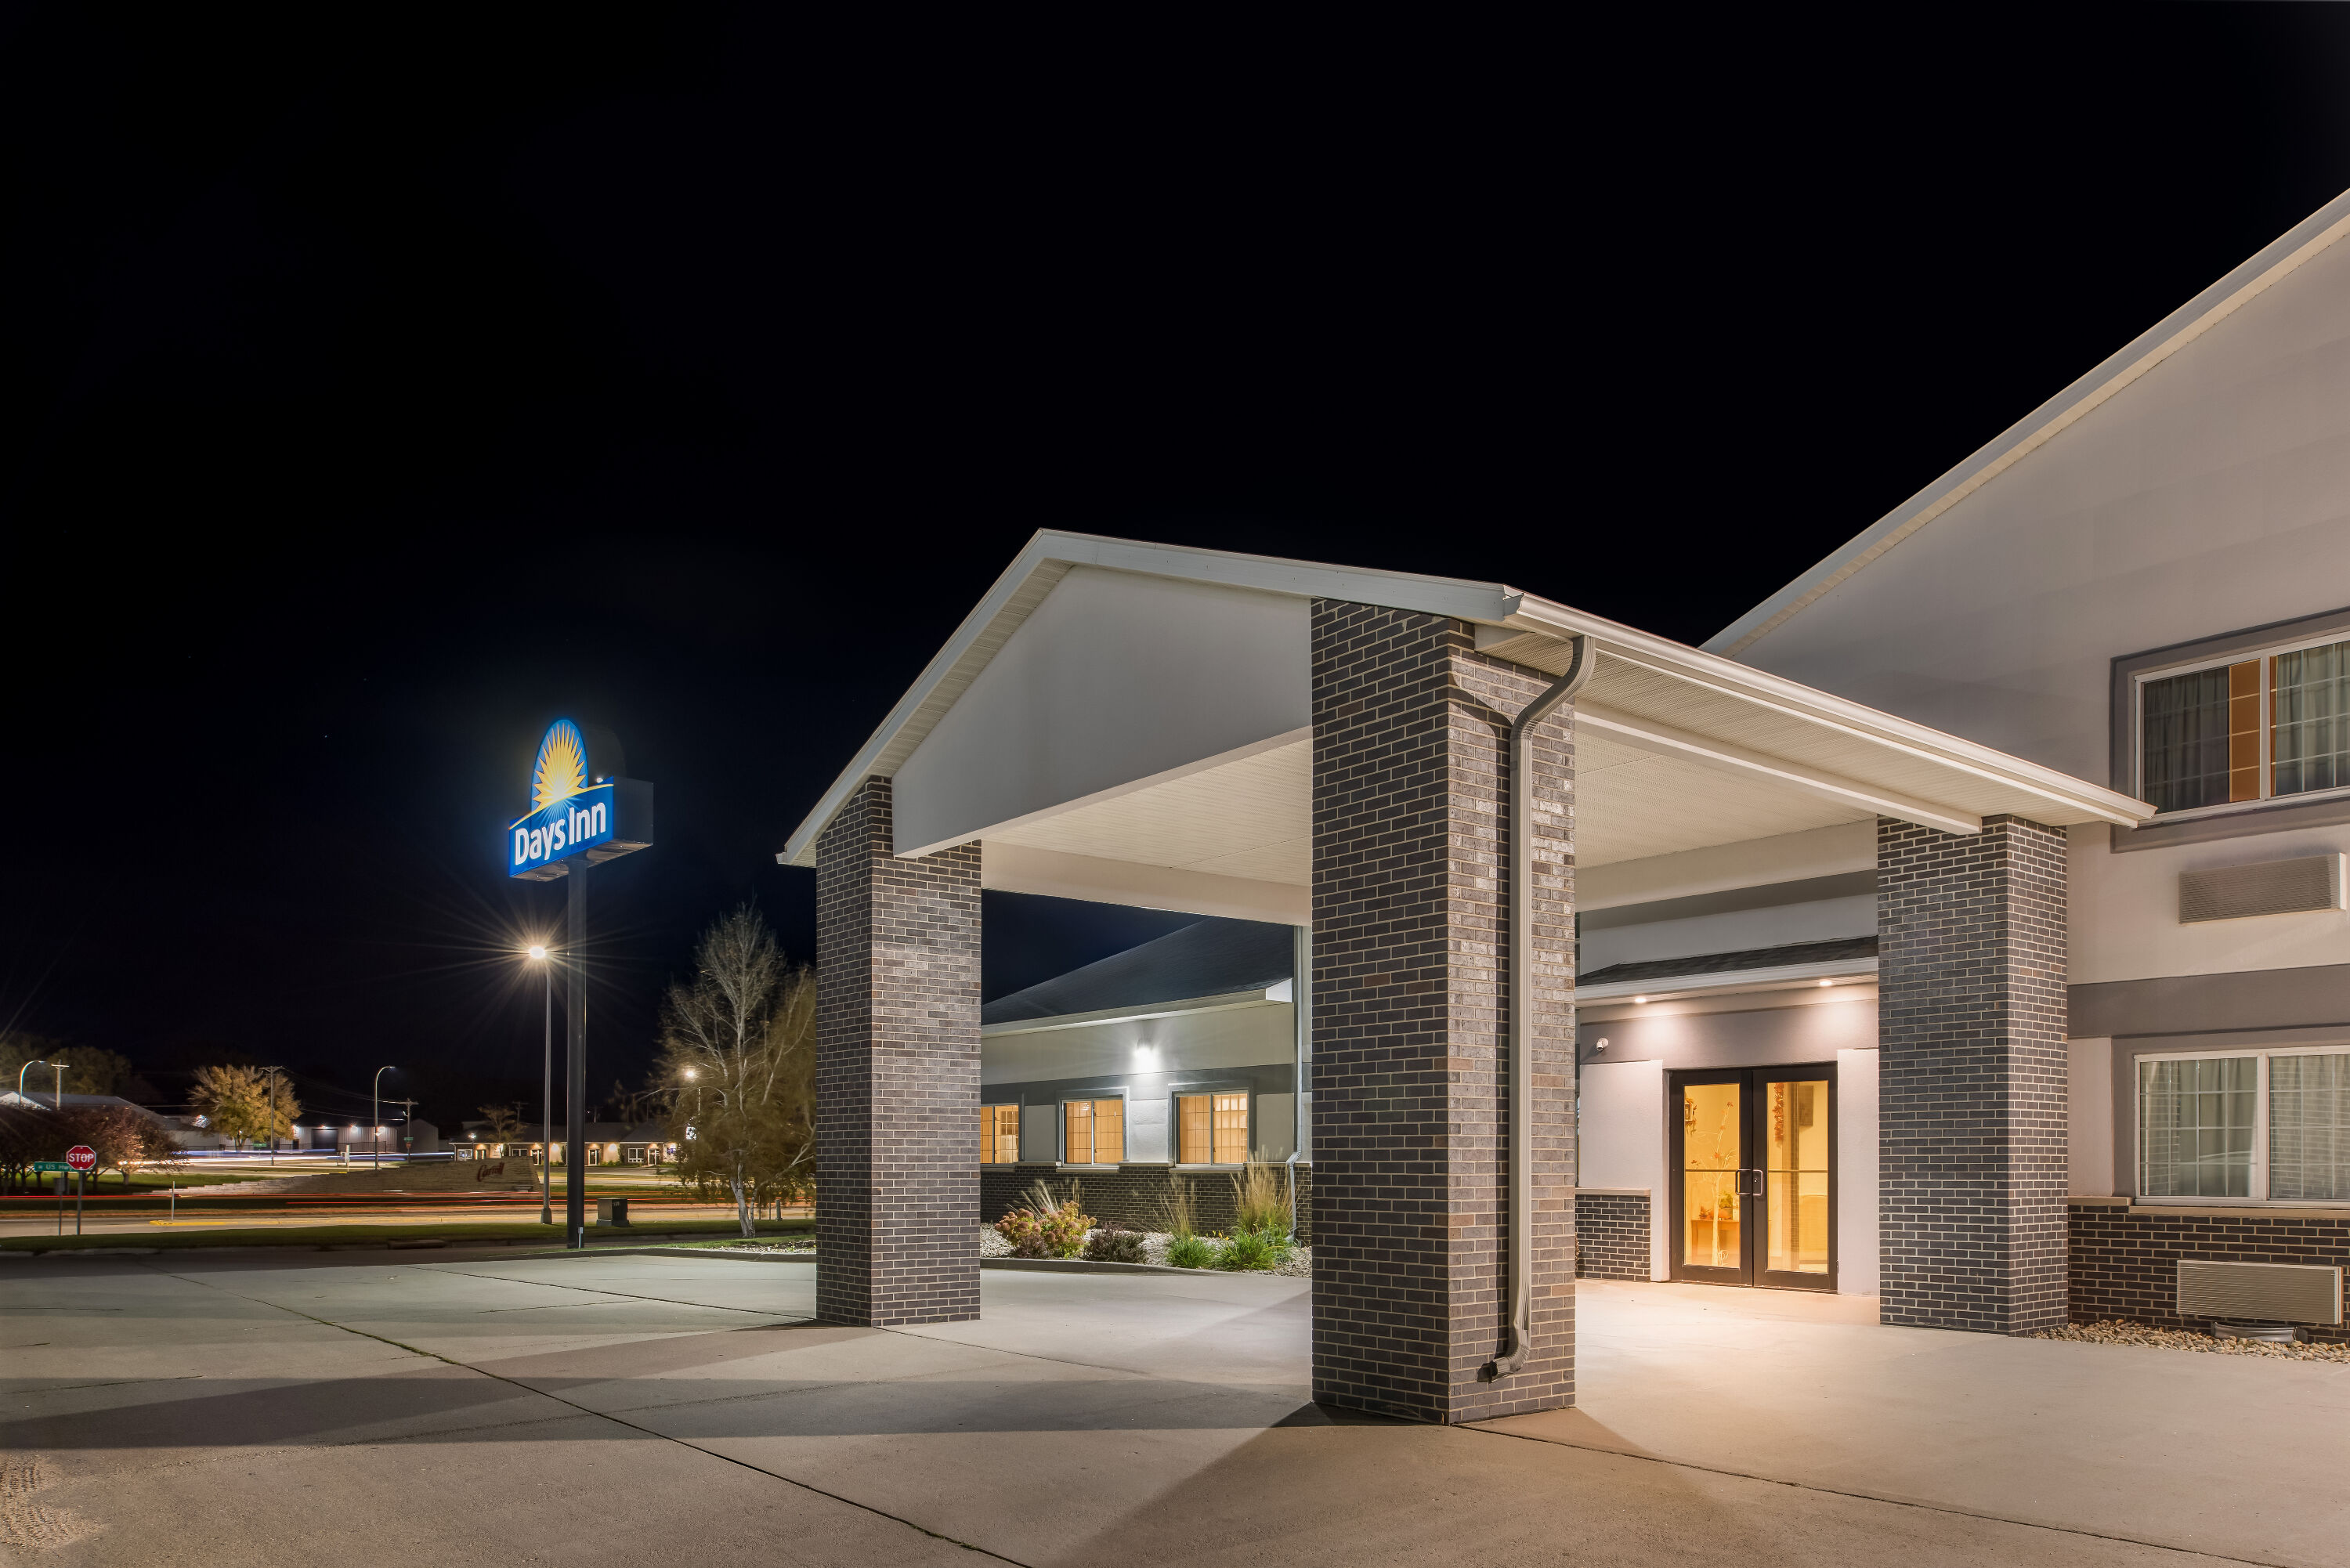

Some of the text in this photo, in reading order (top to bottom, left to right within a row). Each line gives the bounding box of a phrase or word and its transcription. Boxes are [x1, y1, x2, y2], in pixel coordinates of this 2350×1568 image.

[515, 802, 606, 865] Days Inn
[68, 1153, 94, 1163] STOP
